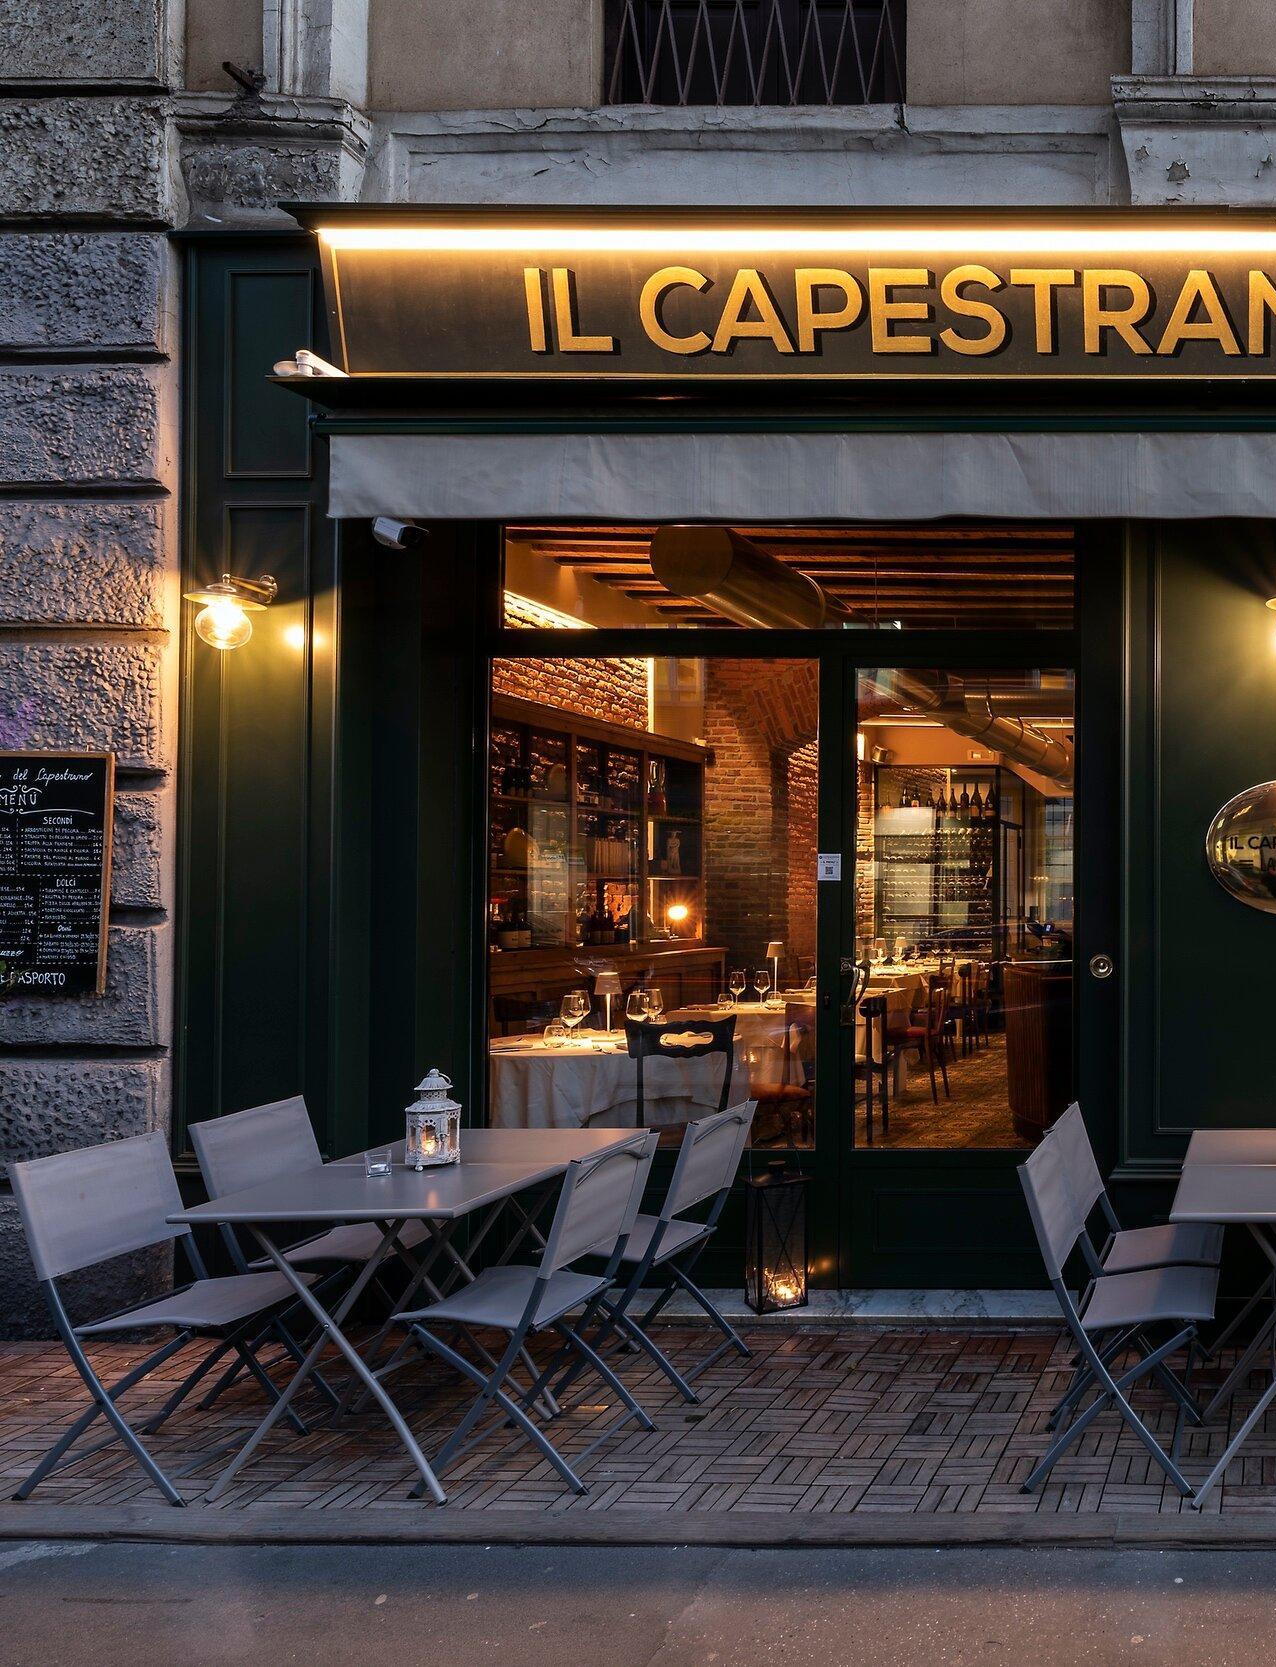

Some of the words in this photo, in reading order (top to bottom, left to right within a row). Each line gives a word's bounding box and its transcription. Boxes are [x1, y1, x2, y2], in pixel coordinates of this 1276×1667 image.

[524, 267, 614, 352] IL
[13, 768, 29, 781] del
[1230, 836, 1244, 850] IL
[1261, 858, 1276, 873] LA
